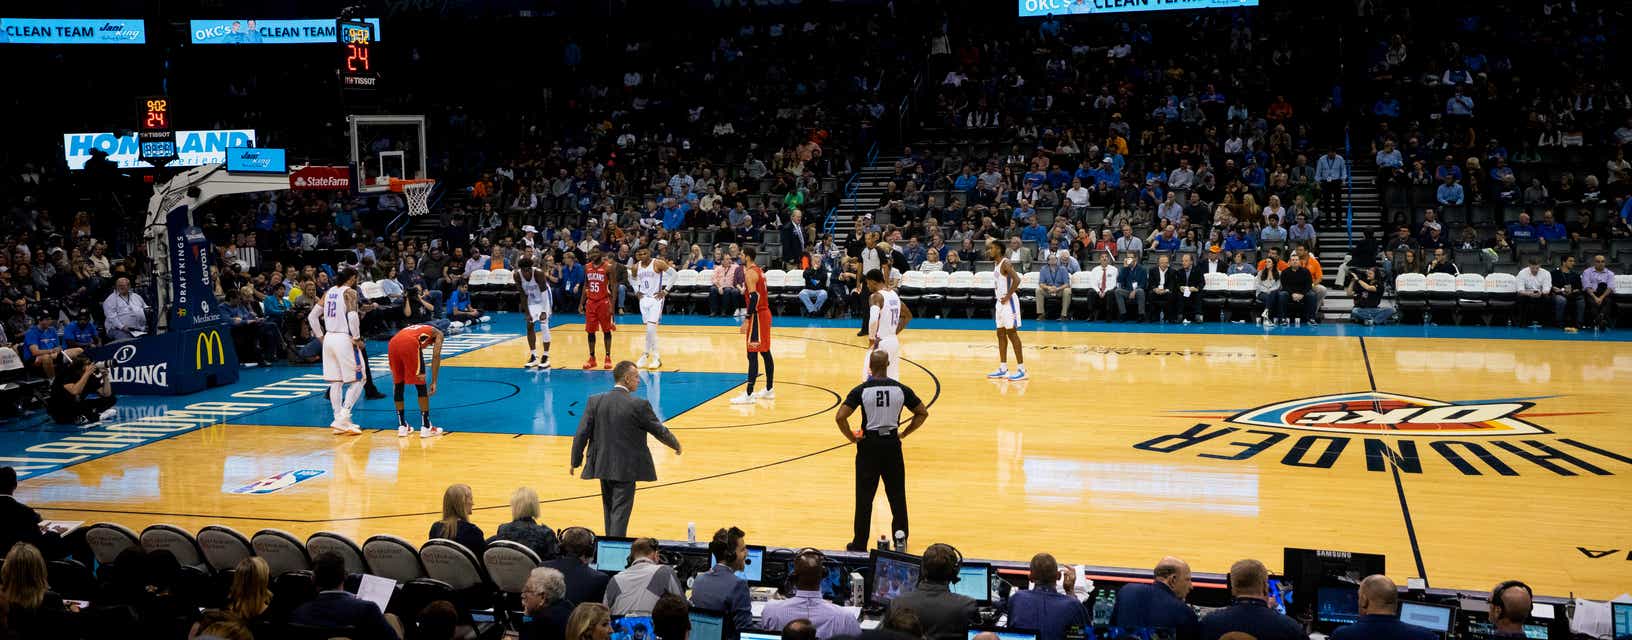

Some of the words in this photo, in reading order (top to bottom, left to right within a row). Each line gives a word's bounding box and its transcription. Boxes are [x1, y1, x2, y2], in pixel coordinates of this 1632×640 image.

[6, 25, 52, 37] CLEAN
[55, 26, 94, 37] TEAM
[195, 23, 232, 41] OKC's
[259, 26, 299, 38] CLEAN
[303, 26, 336, 37] TEAM
[347, 44, 369, 71] 24
[355, 77, 376, 86] TISSOT
[147, 100, 167, 112] 9:02
[147, 112, 164, 127] 24
[177, 235, 187, 303] DRAFTKINGS
[200, 247, 210, 286] devon
[589, 281, 601, 293] 55
[327, 301, 337, 317] 12
[193, 313, 221, 325] Medicine
[876, 390, 890, 407] 21
[1316, 549, 1352, 559] SAMSUNG
